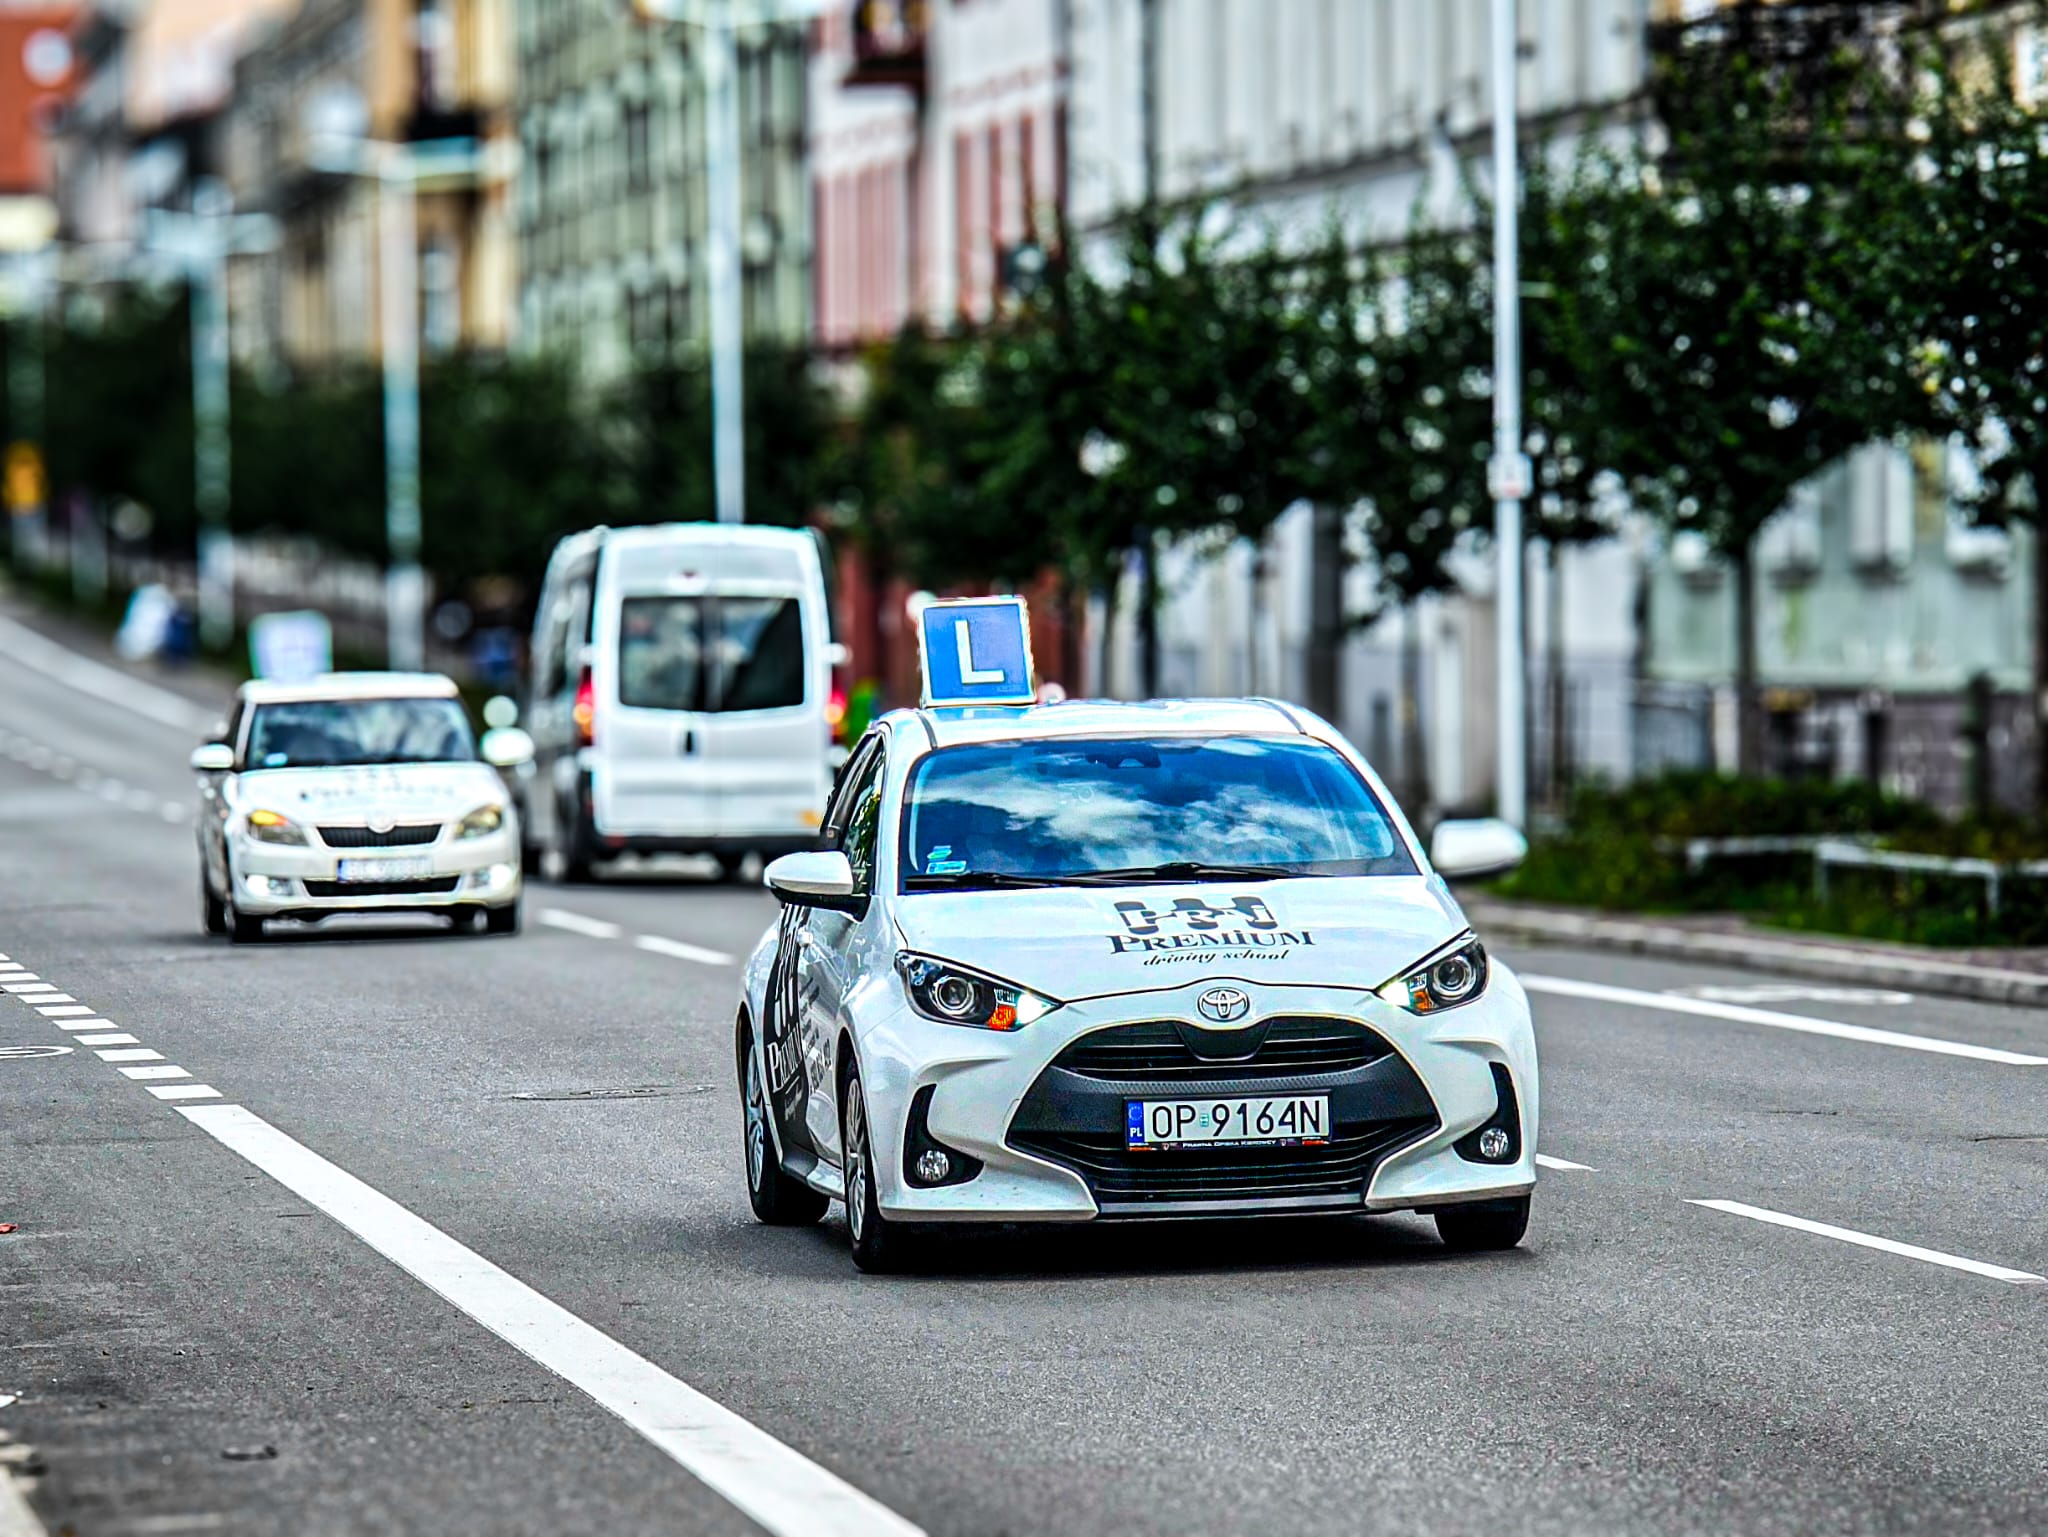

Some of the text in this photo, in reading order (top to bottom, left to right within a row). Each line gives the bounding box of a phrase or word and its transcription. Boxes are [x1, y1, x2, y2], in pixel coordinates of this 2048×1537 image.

[955, 619, 1005, 684] L
[1143, 949, 1290, 966] driving school
[1129, 1127, 1143, 1138] PL
[1152, 1100, 1321, 1138] OP 9164N
